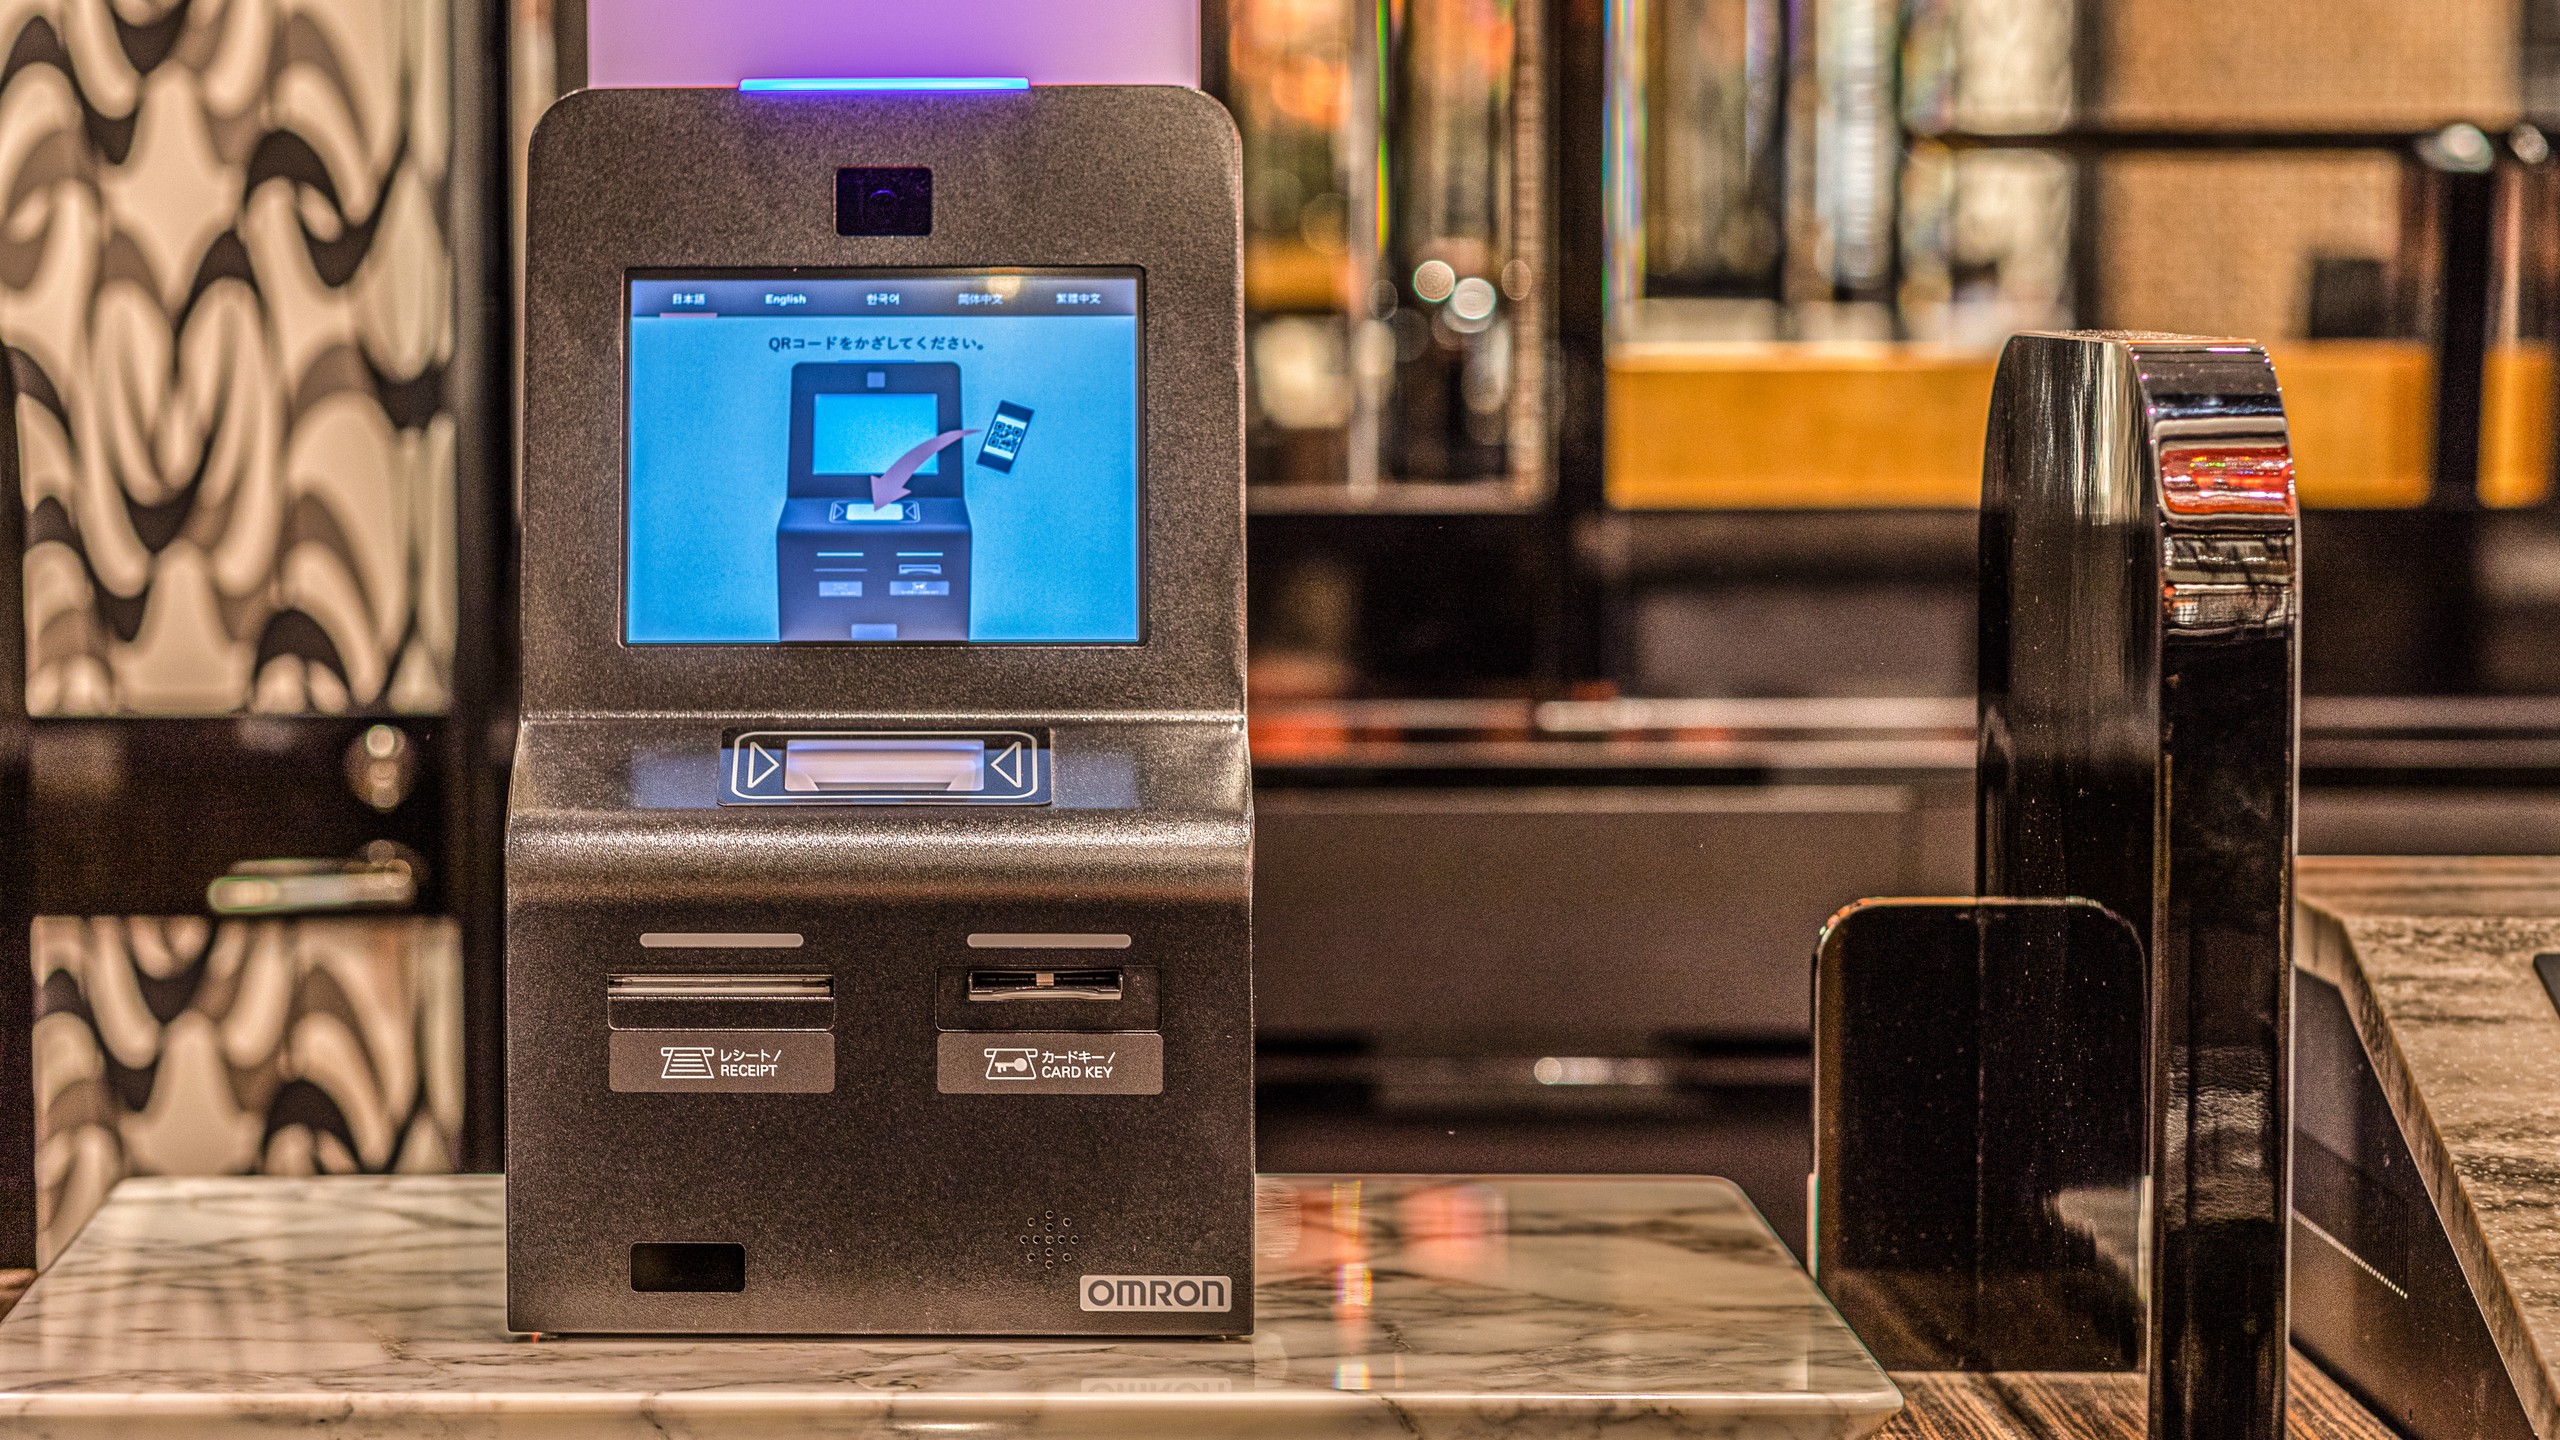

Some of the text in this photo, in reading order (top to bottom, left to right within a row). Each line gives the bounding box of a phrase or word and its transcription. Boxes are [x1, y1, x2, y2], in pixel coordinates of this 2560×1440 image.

[672, 293, 706, 305] 日本語
[765, 294, 807, 307] English
[866, 293, 900, 306] 한국어
[768, 336, 984, 352] QRコードをかざしてください。
[720, 1064, 778, 1077] RECEIPT
[1041, 1065, 1113, 1079] CARD KEY
[1087, 1279, 1224, 1307] OMRON
